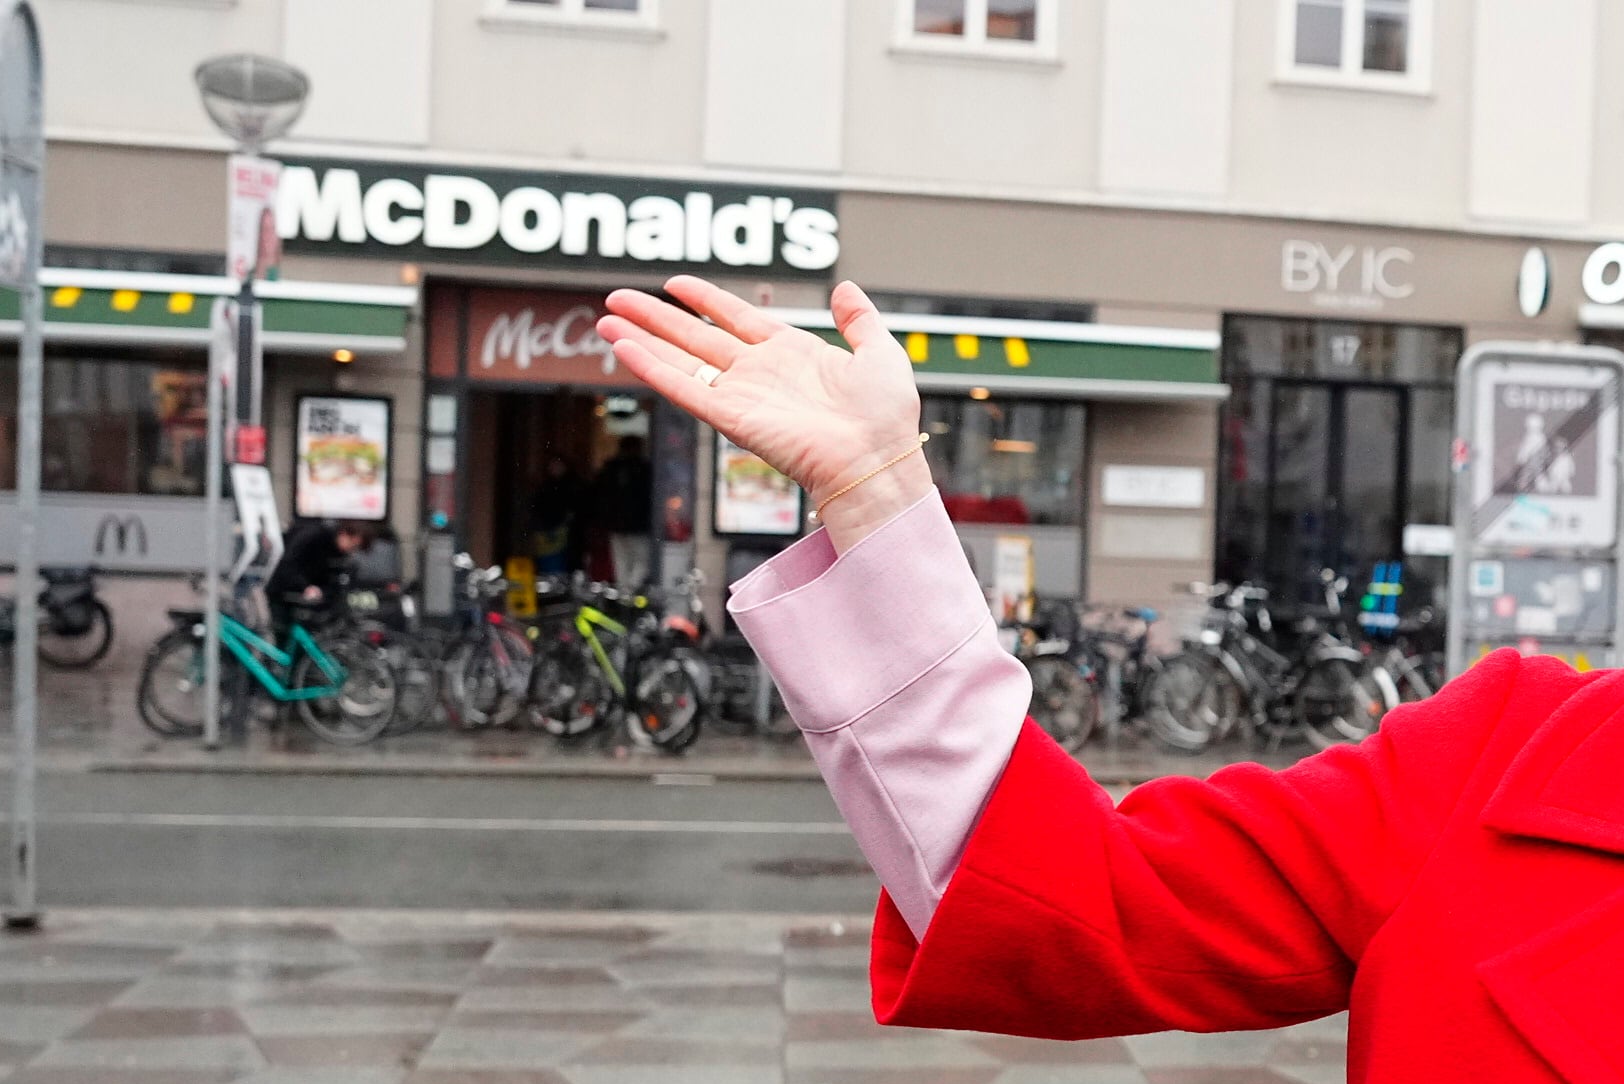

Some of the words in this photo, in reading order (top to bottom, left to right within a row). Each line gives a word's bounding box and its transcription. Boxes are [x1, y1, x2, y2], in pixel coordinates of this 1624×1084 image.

[275, 165, 840, 270] McDonald's
[1281, 239, 1355, 292] BY
[480, 305, 617, 375] McCa
